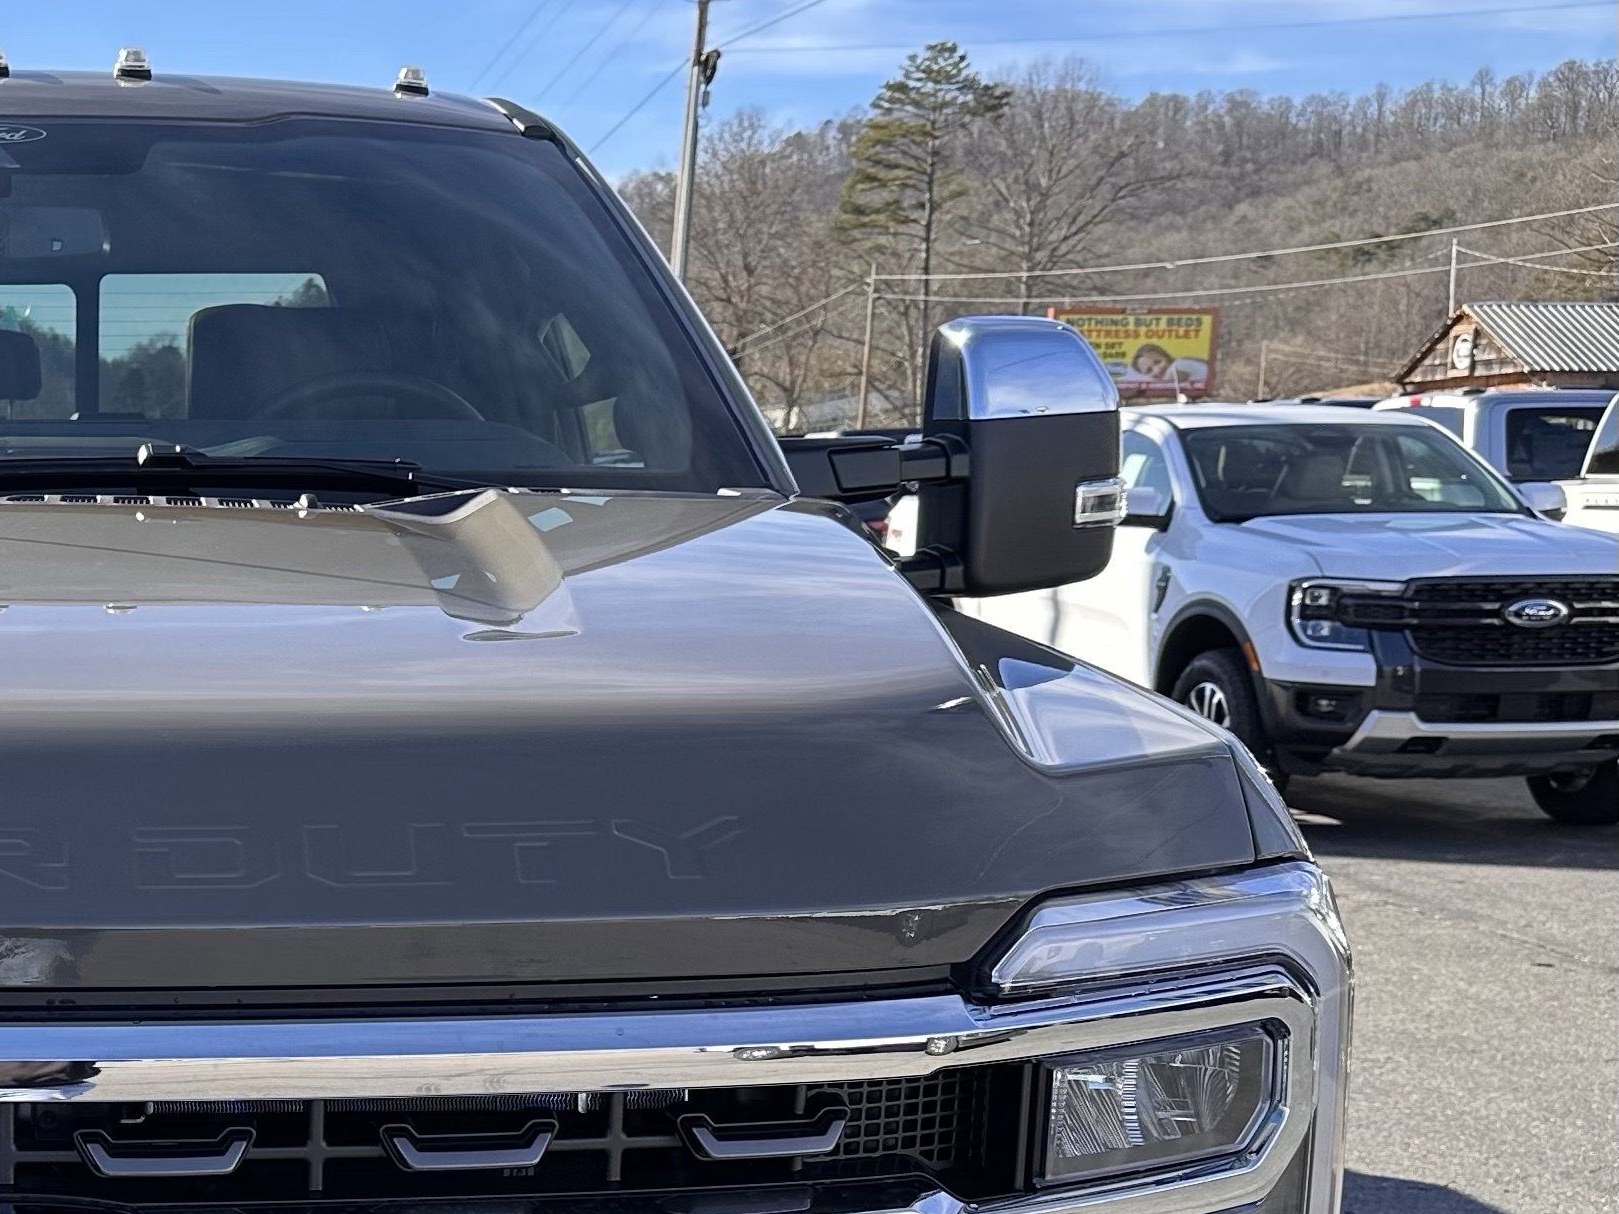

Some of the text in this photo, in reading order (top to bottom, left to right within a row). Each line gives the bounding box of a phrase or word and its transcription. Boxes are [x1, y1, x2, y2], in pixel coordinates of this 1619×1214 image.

[1134, 317, 1161, 328] BUT
[1166, 316, 1203, 328] BEDS
[1145, 328, 1201, 339] OUTLET
[132, 815, 748, 889] DUTY
